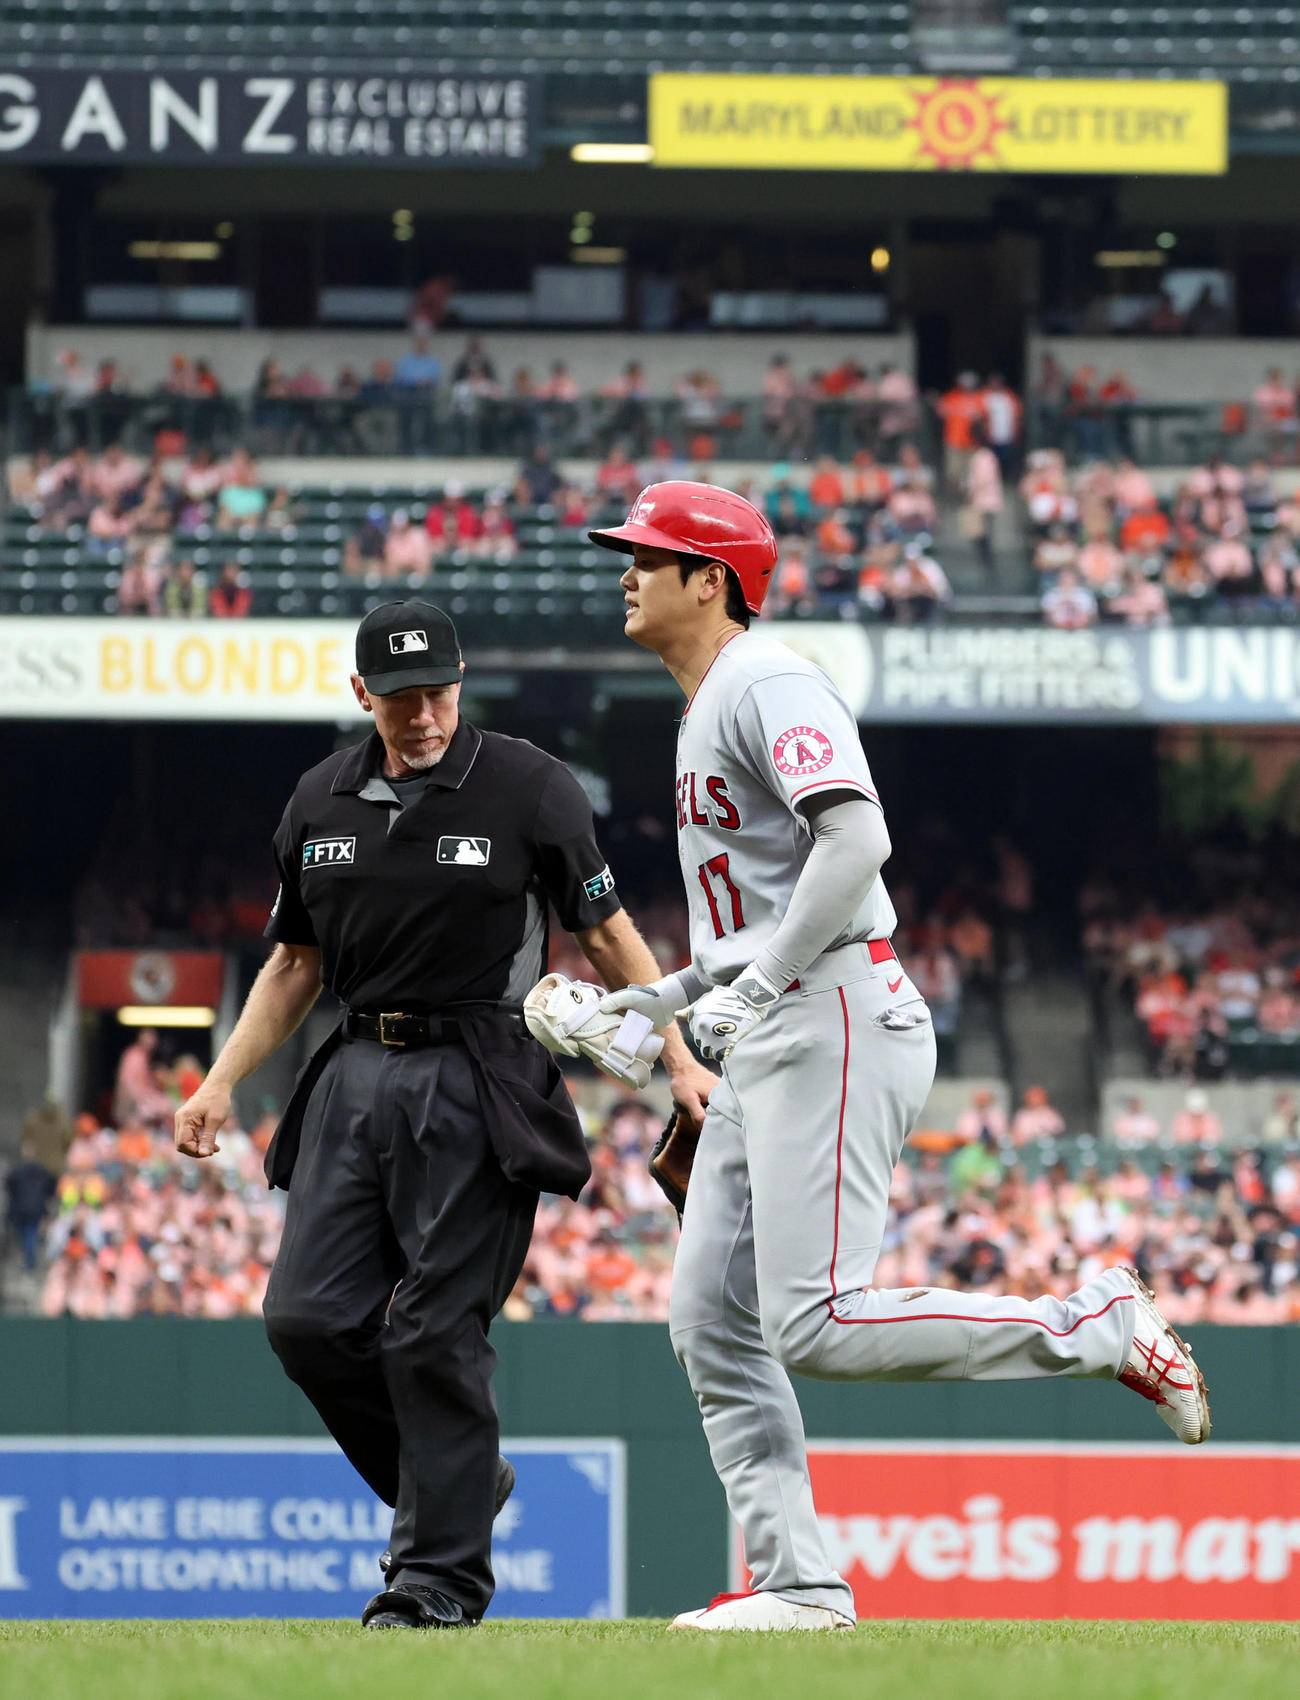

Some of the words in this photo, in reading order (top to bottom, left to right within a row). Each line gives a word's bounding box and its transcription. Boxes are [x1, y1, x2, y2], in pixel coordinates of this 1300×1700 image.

[307, 78, 528, 118] EXCLUSIVE
[307, 117, 394, 157] REAL
[403, 117, 528, 158] ESTATE
[679, 99, 905, 141] MARYLAND
[1007, 102, 1196, 144] LOTTERY
[0, 639, 84, 697] SS
[99, 635, 345, 695] BLONDE
[883, 627, 1097, 667] PLUMBERS
[1150, 626, 1300, 700] UNI
[883, 670, 974, 707] PIPE
[981, 670, 1142, 709] FITTERS
[776, 727, 817, 747] ANGELS
[314, 841, 352, 863] FTX
[698, 852, 746, 940] 17
[60, 1497, 167, 1540] LAKE
[174, 1497, 265, 1540] ERIE
[817, 1494, 1061, 1582] weis
[58, 1548, 343, 1591] OSTEOPATHIC
